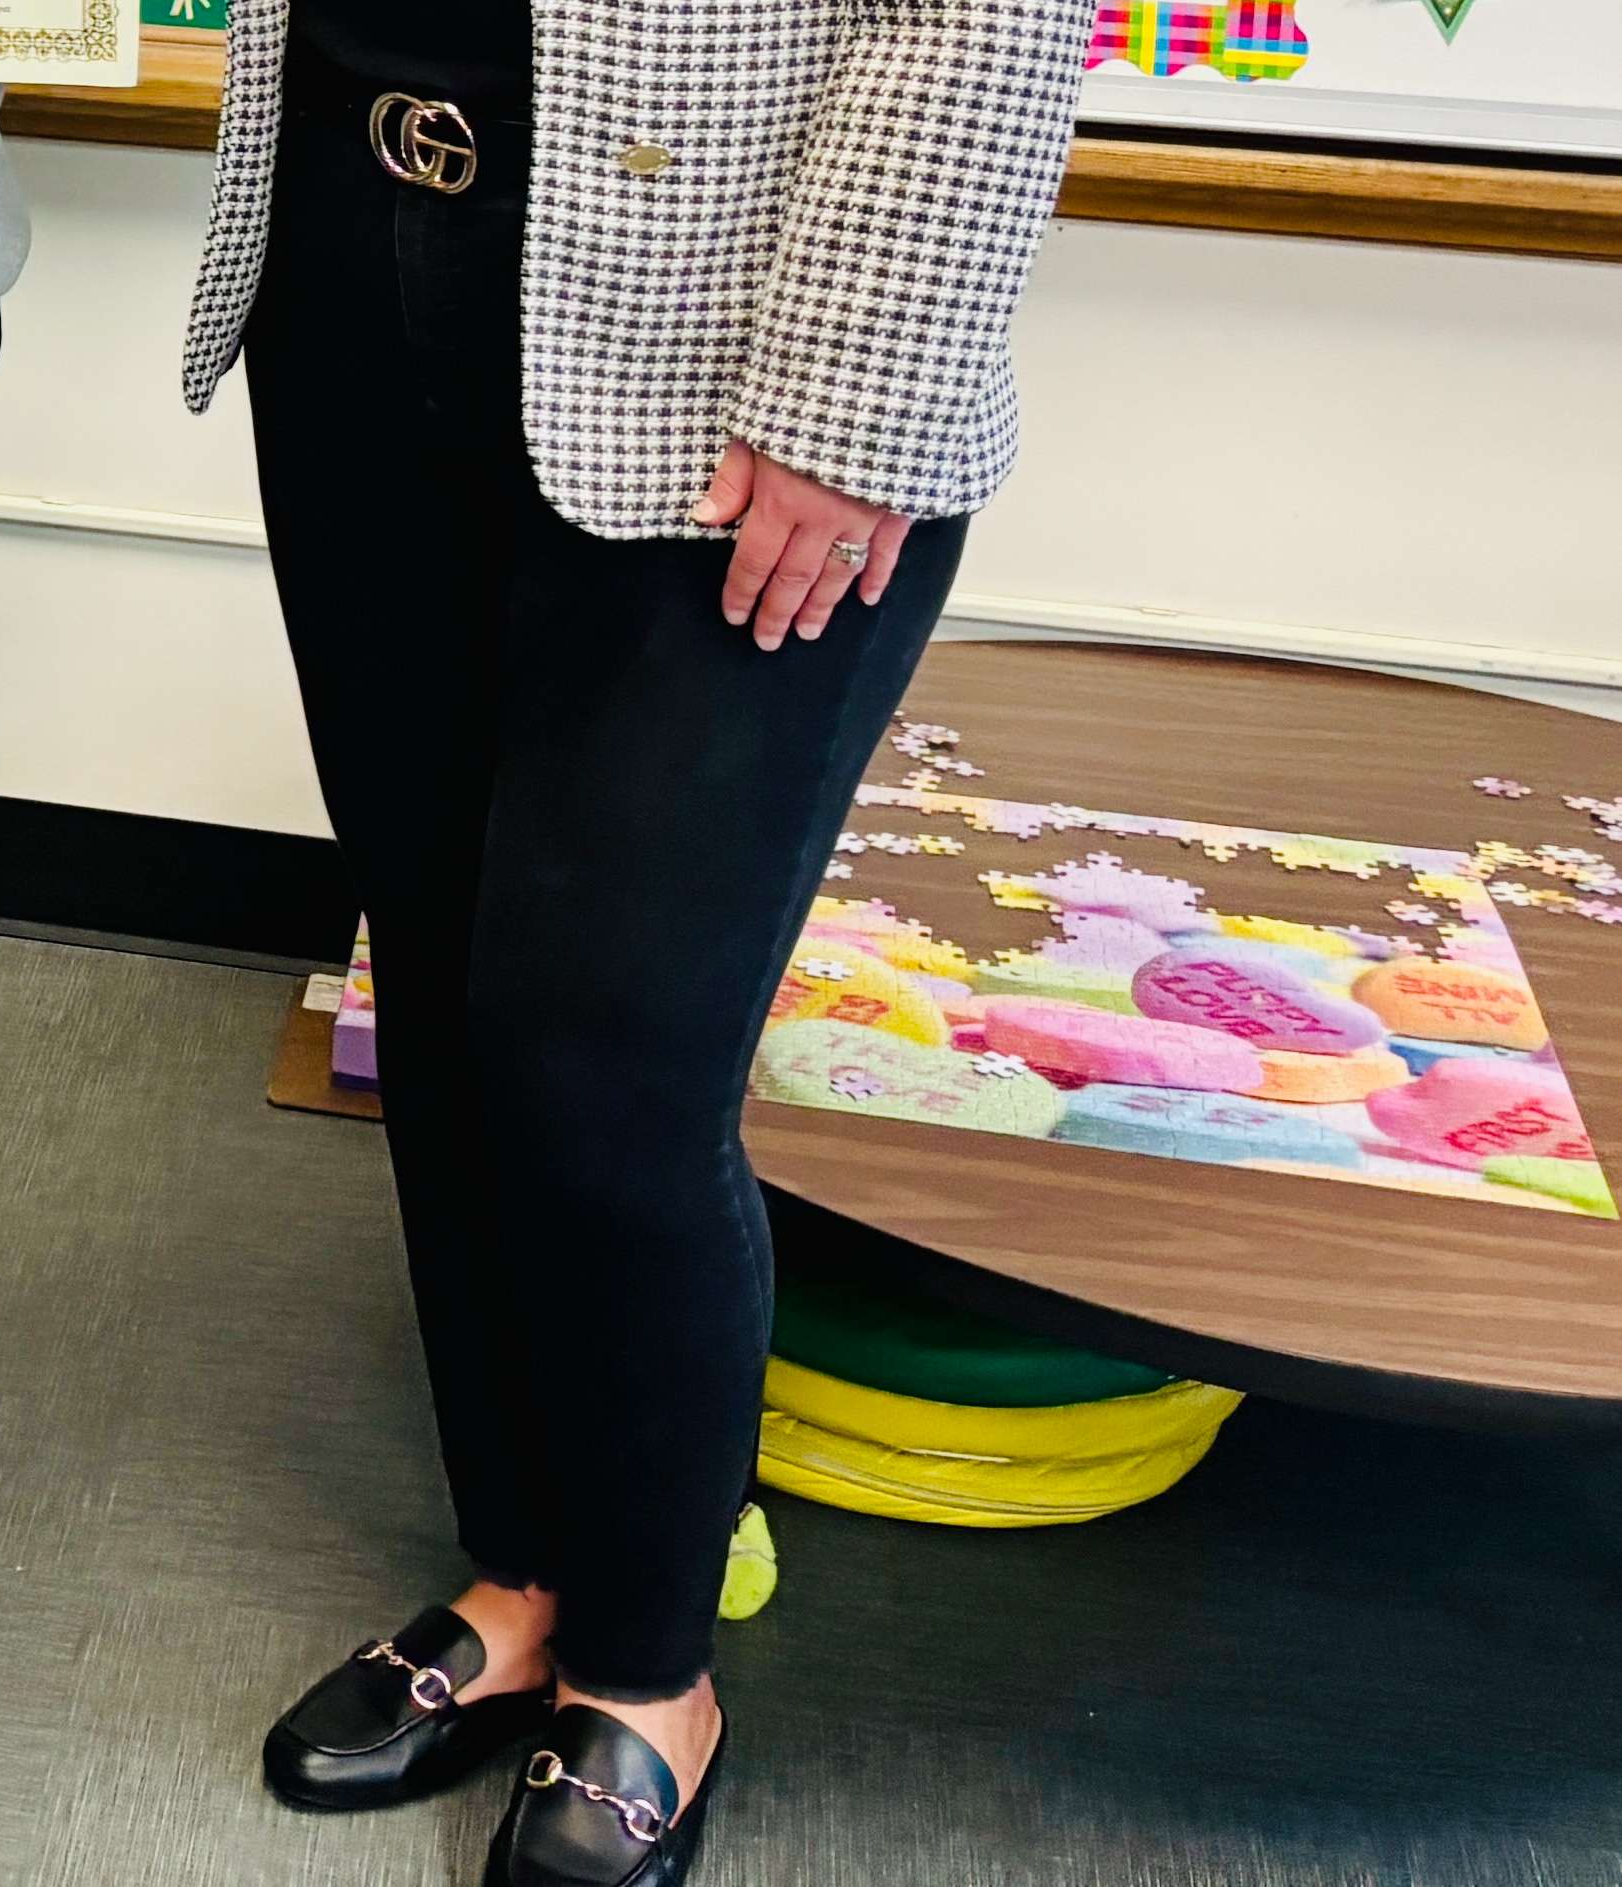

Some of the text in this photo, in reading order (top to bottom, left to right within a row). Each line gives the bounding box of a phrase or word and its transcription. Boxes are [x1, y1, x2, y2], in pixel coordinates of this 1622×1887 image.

[1150, 976, 1275, 1038] LOVE
[1184, 961, 1345, 1035] PUPPY
[1443, 1098, 1570, 1156] FIRST
